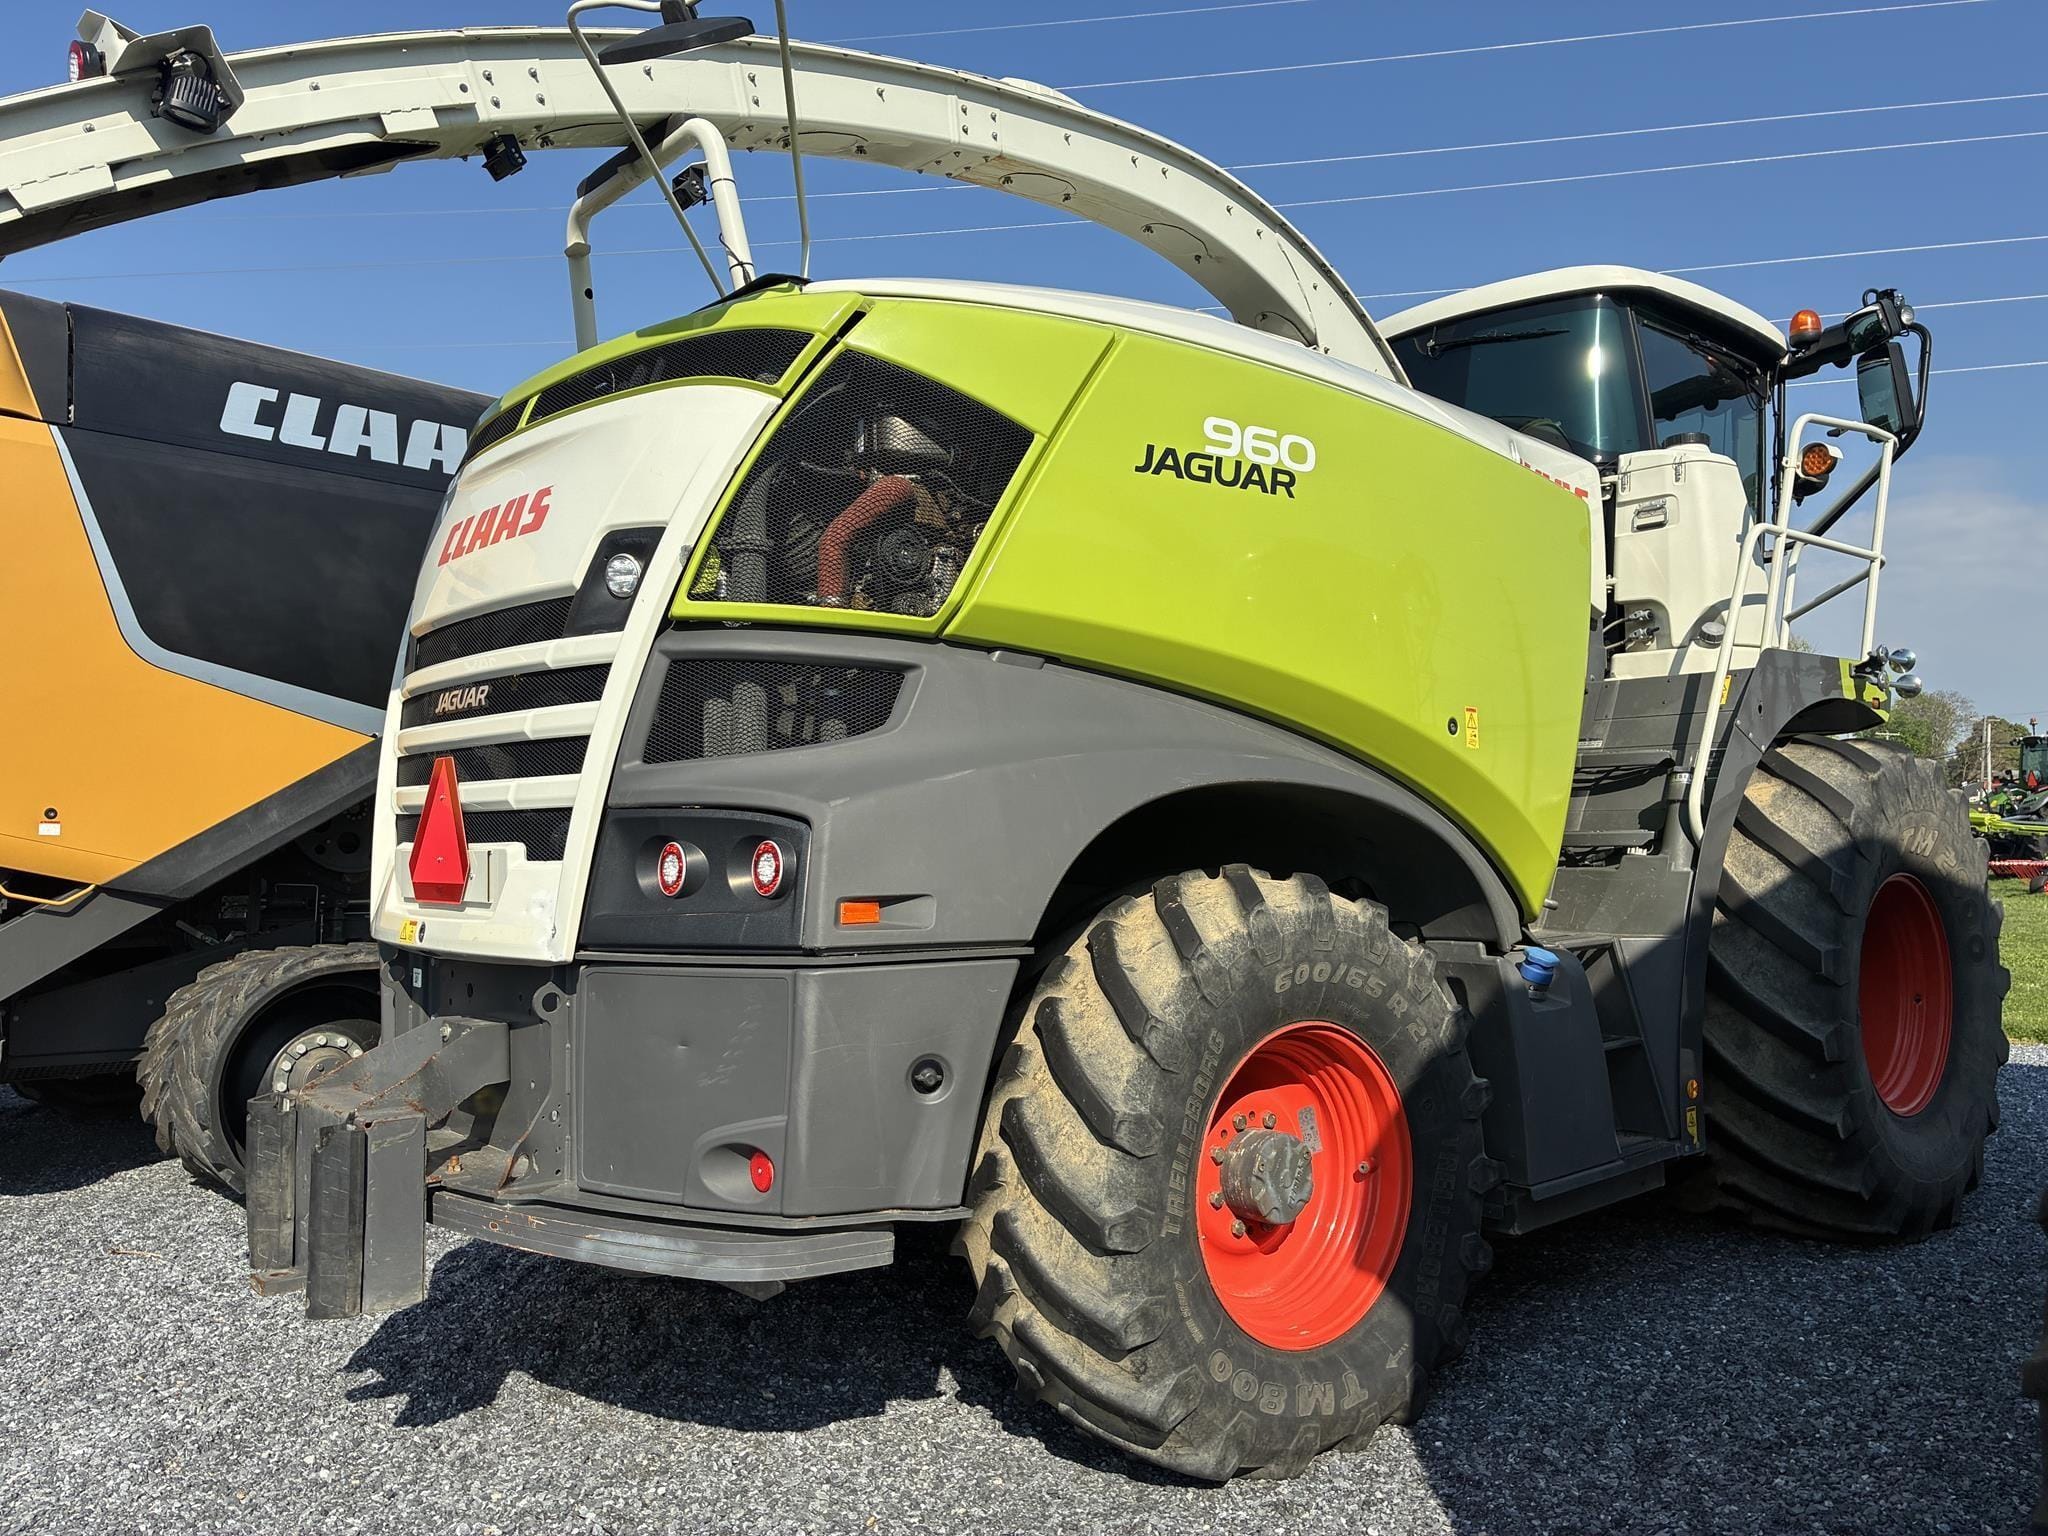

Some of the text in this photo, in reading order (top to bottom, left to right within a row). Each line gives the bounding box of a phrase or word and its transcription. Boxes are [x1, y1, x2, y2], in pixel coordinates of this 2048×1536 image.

[1134, 444, 1297, 499] JAGUAR
[1202, 416, 1317, 473] 960
[437, 485, 555, 568] CLAAS
[434, 684, 491, 716] JAGUAR
[1273, 961, 1388, 999] 600/65
[1160, 1028, 1226, 1238] TRELLEBORG
